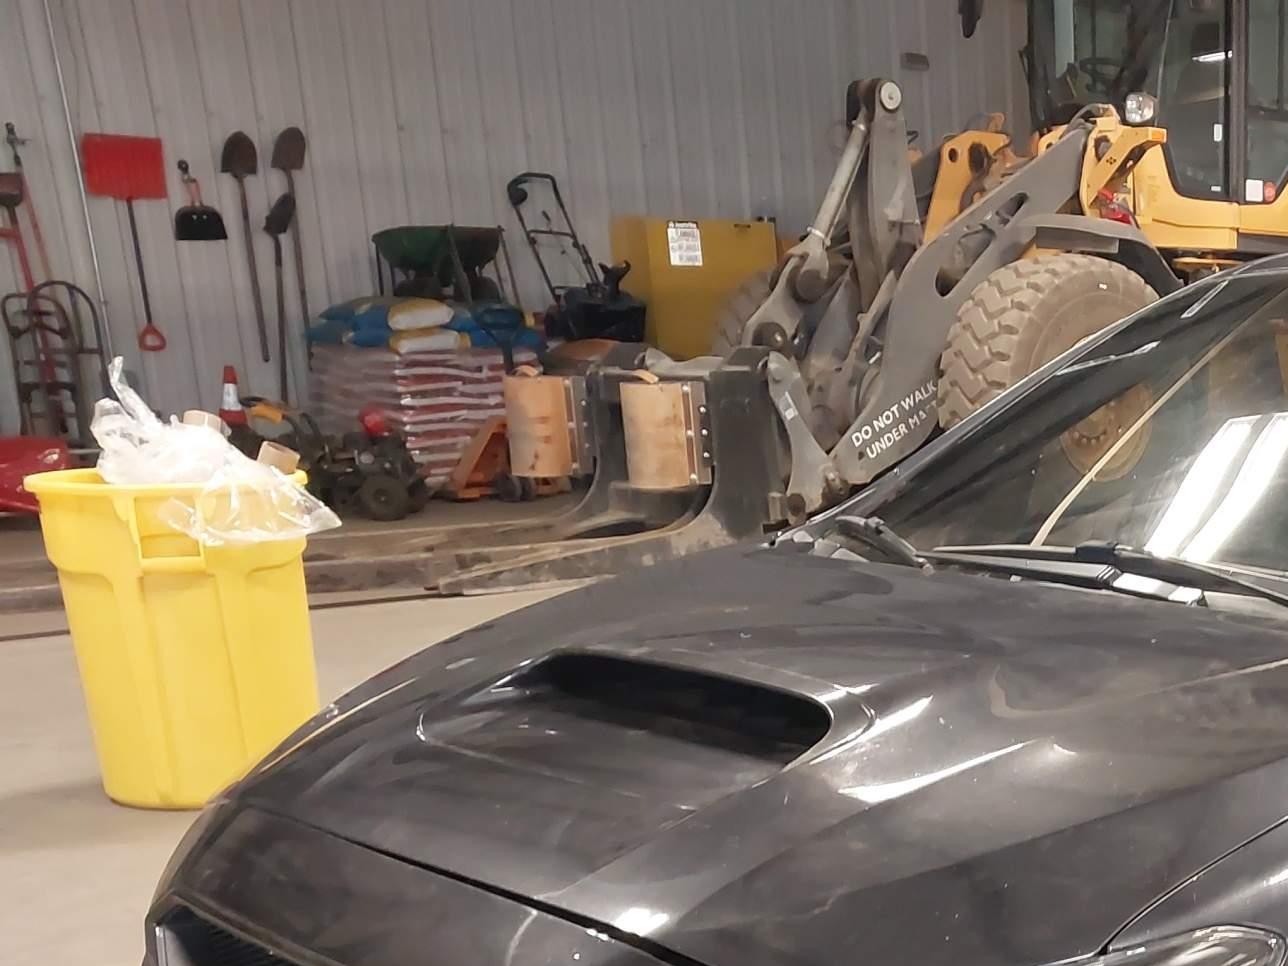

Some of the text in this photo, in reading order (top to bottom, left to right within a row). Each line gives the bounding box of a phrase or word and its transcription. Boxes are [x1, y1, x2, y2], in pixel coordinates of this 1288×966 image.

[851, 380, 937, 448] DO NOT WALK
[866, 423, 908, 459] UNDER
